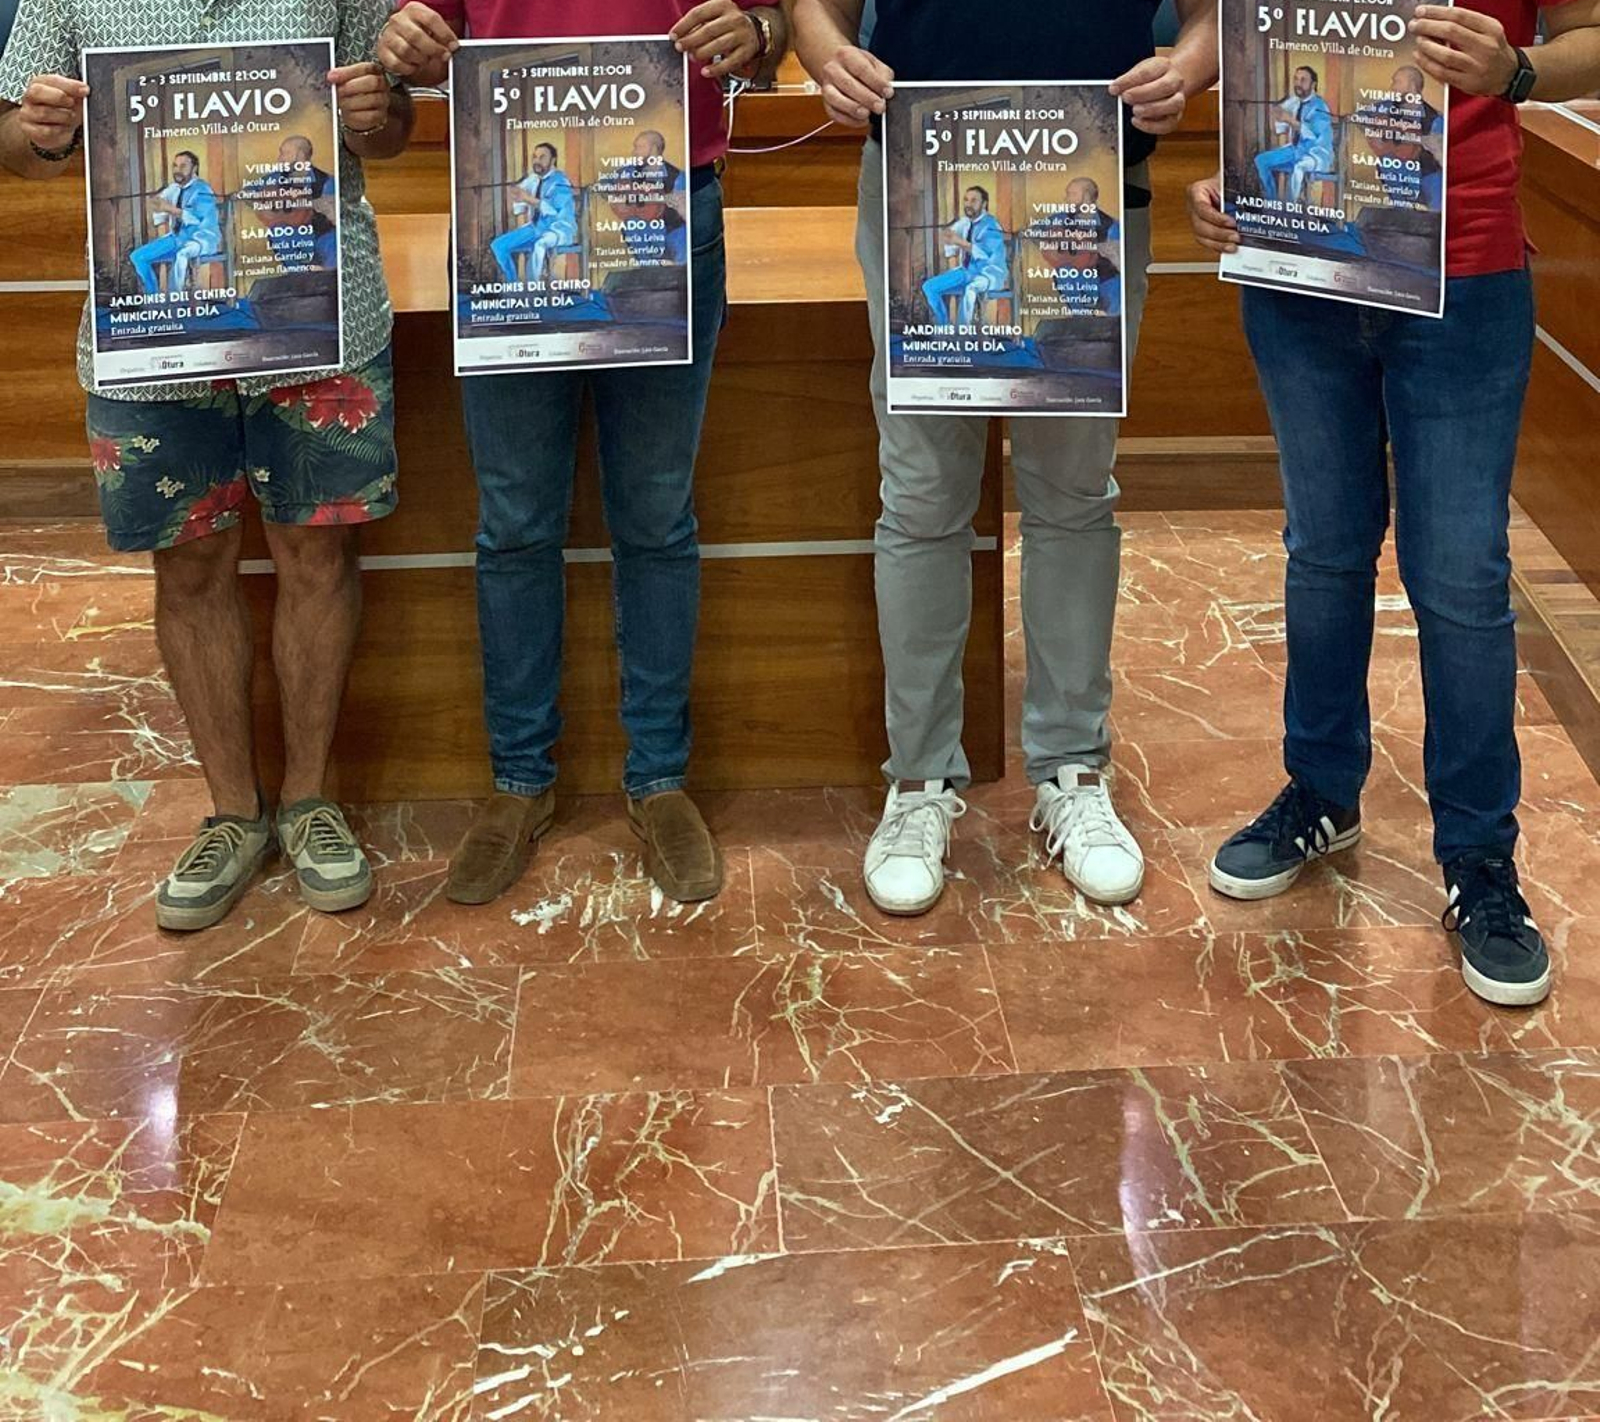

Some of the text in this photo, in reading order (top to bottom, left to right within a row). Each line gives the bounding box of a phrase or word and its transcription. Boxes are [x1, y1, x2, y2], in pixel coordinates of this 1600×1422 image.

[1297, 8, 1405, 42] FLAVIO
[1270, 37, 1393, 58] Flamenco Villa de Otura
[138, 68, 277, 86] 2 3 SEPTIEMBRE 21:00H
[502, 64, 631, 78] 2 3 SEPTIEMBRE 21:00H
[173, 86, 291, 120] FLAVIO
[534, 82, 645, 112] FLAVIO
[1359, 88, 1421, 104] VIERNES 02
[505, 114, 634, 129] Flamenco Villa de Otura
[933, 109, 1064, 120] 2 3 SEPTIEMBRE 21:00H
[143, 119, 279, 139] Flamenco Villa de Otura
[965, 128, 1078, 155] FLAVIO
[245, 160, 311, 174] VIERNES 02
[601, 155, 663, 167] VIERNES 02
[937, 160, 1066, 172] Flamenco Villa de Otura
[1352, 150, 1420, 171] SÁBADO 03
[242, 174, 311, 188] Jacob de Carmen
[597, 169, 663, 180] Jacob de Carmen
[236, 185, 312, 199] Christian Delgado
[592, 180, 664, 192] Christian Delgado
[274, 200, 283, 209] El
[628, 193, 636, 202] El
[1032, 203, 1096, 213] VIERNES 02
[1235, 194, 1345, 220] JARDINES DEL CENTRO
[595, 216, 664, 231] SÁBADO 03
[1029, 217, 1096, 226] Jacob de Carmen
[1235, 209, 1329, 234] MUNICIPAL DE DÍA
[240, 223, 313, 239] SÁBADO 03
[1024, 229, 1097, 240] Christian Delgado
[627, 244, 658, 254] Garrido
[659, 246, 665, 255] y
[1060, 241, 1068, 250] El
[274, 250, 307, 261] Garrido
[308, 252, 314, 261] y
[599, 258, 628, 268] cuadro
[245, 265, 275, 276] cuadro
[1027, 265, 1097, 278] SÁBADO 03
[470, 278, 590, 294] JARDINES DEL CENTRO
[108, 286, 236, 307] JARDINES DEL CENTRO
[470, 292, 574, 310] MUNICIPAL DE DÍA
[1059, 294, 1091, 303] Garrido
[1092, 296, 1098, 305] y
[109, 302, 219, 324] MUNICIPAL DE DÍA
[471, 311, 540, 322] Entrada gratuita
[1030, 306, 1059, 315] cuadro
[110, 321, 184, 336] Entrada gratuita
[902, 324, 1022, 336] JARDINES DEL CENTRO
[902, 338, 1005, 352] MUNICIPAL DE DÍA
[903, 354, 971, 365] Entrada gratuita
